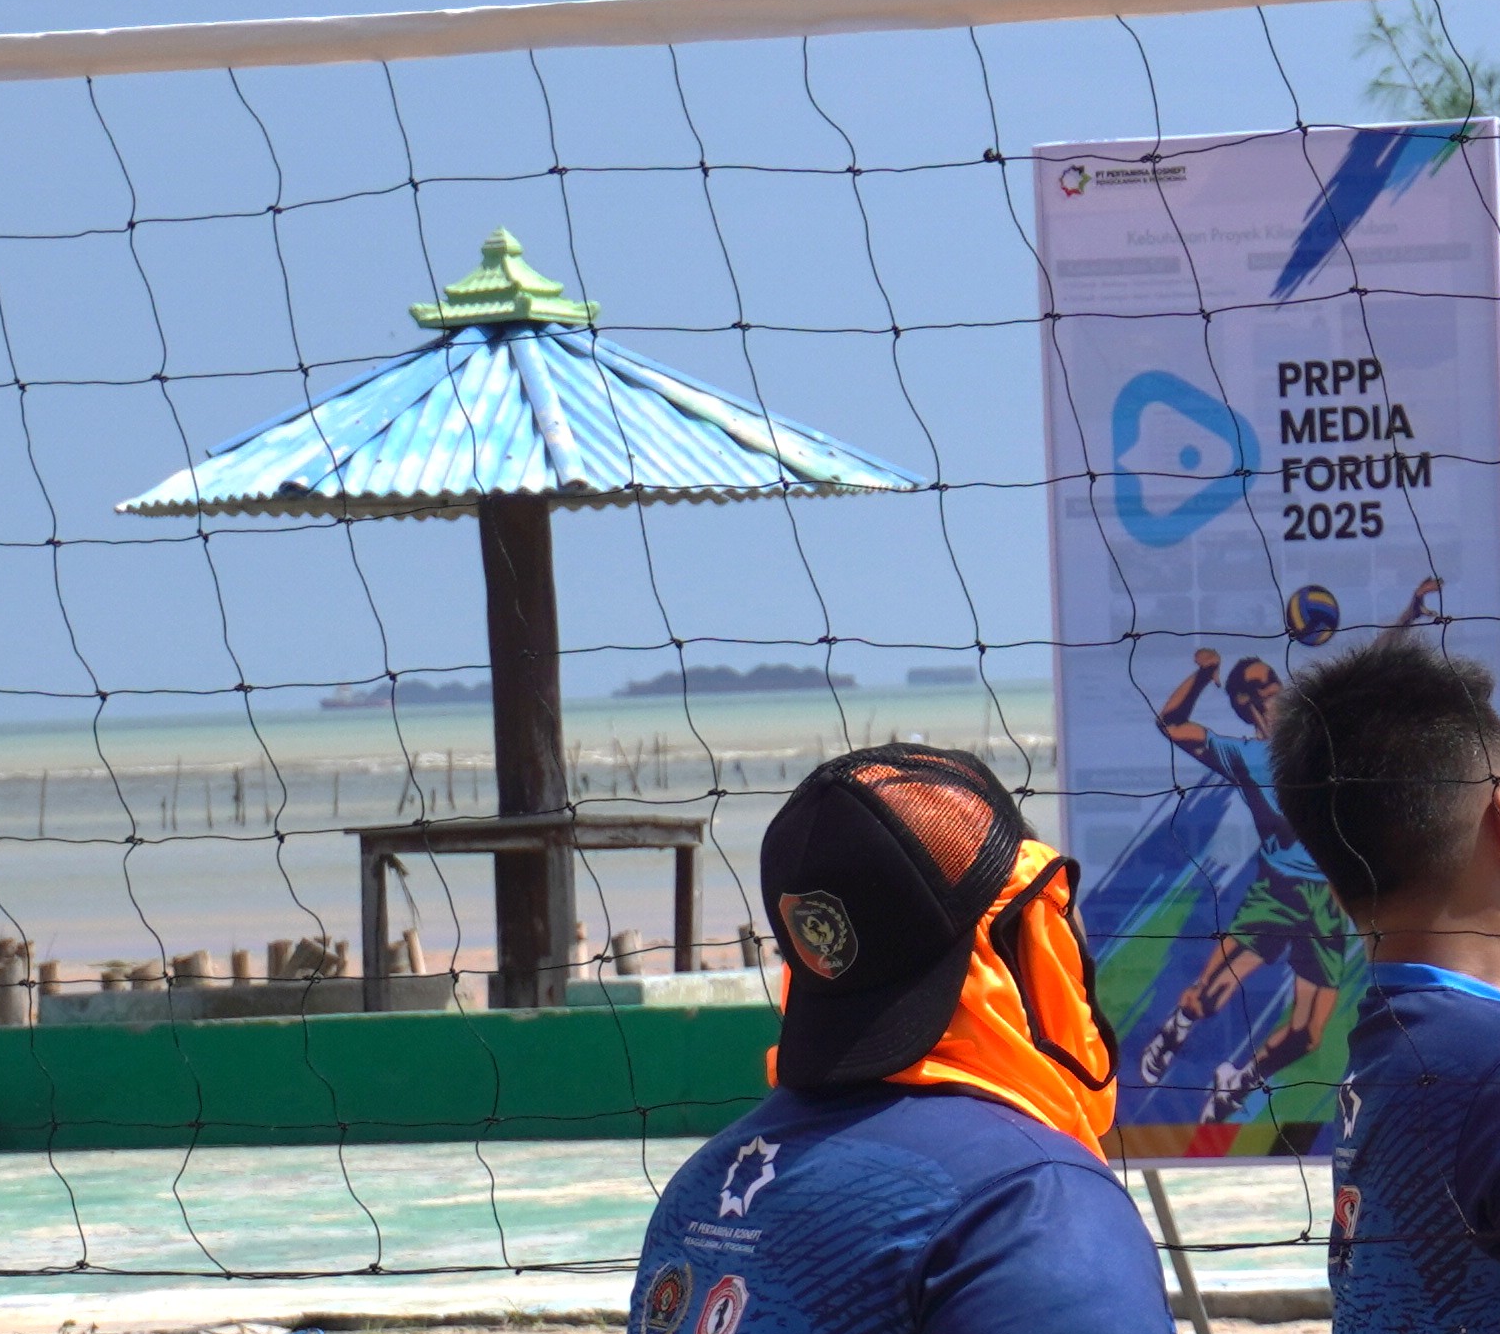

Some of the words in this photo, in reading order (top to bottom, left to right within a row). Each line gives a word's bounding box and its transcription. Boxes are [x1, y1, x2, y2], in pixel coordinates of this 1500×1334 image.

[1278, 358, 1381, 397] PRPP
[1280, 403, 1414, 444] MEDIA
[1282, 451, 1432, 493] FORUM
[1283, 501, 1384, 541] 2025
